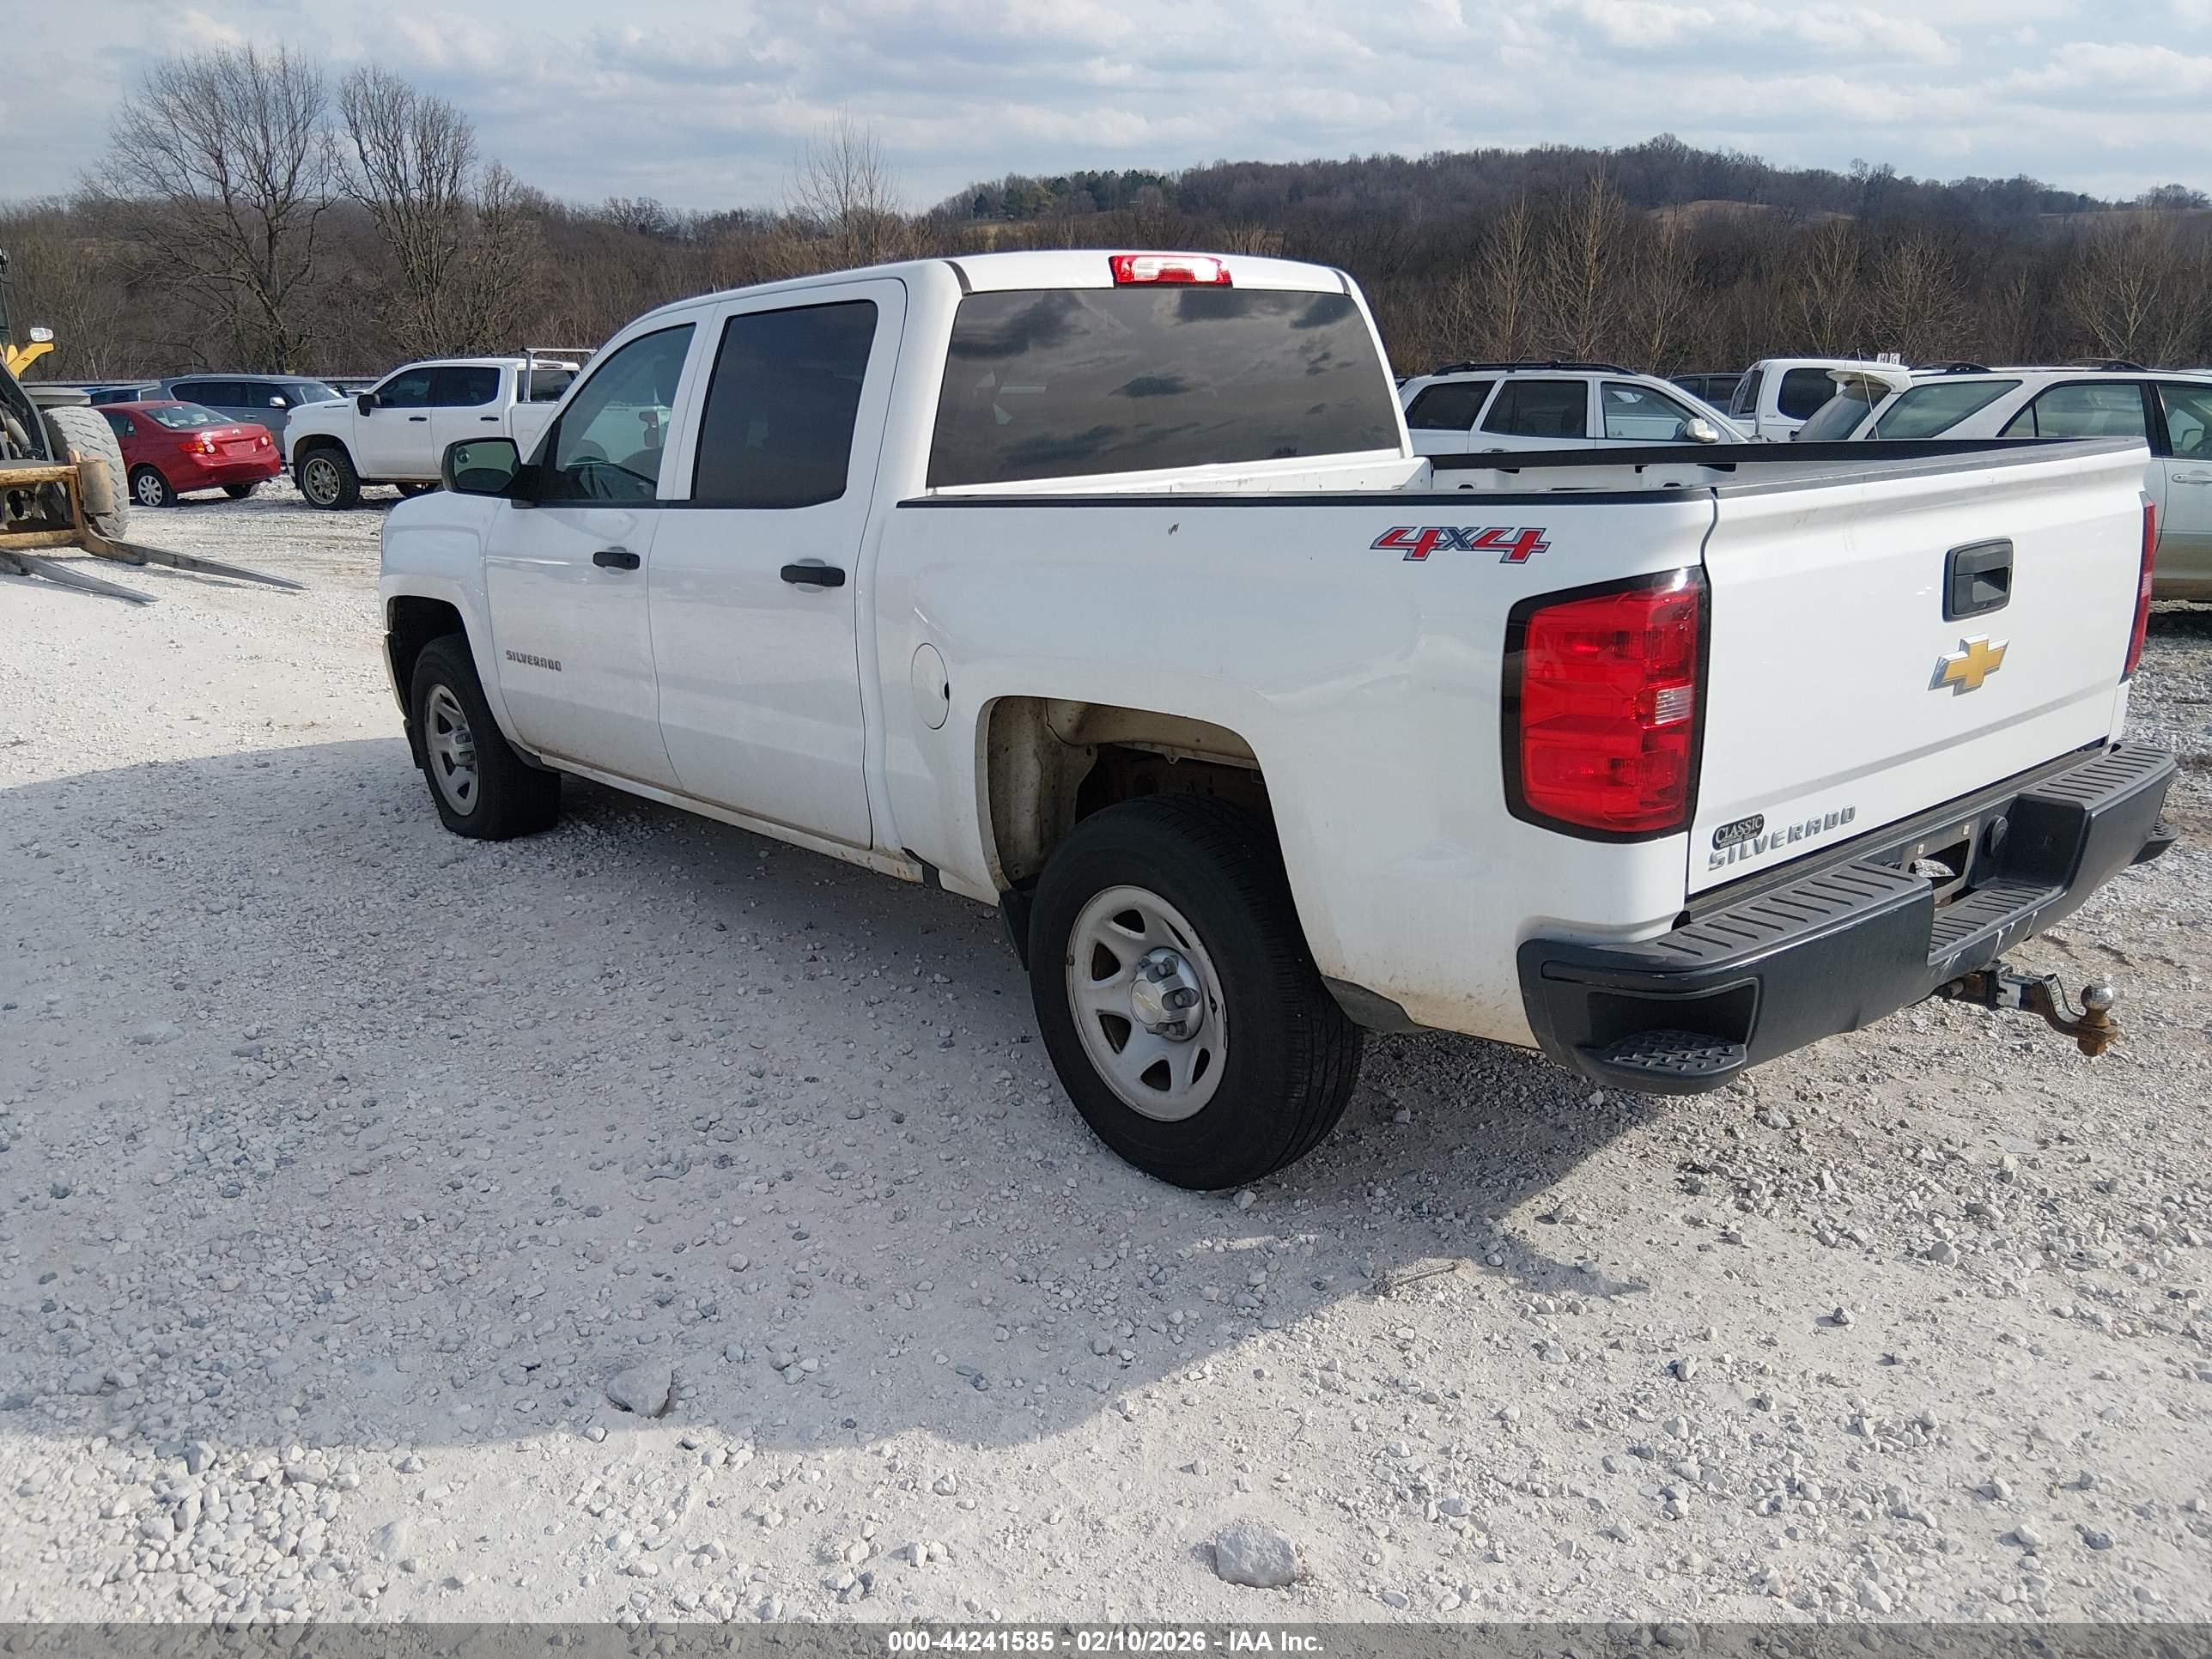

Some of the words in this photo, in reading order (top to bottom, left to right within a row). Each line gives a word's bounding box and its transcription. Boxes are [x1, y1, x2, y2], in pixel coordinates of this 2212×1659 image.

[505, 649, 562, 672] SILVERADO
[1707, 805, 1856, 872] SILVERADO
[1715, 816, 1763, 844] CLASSIC
